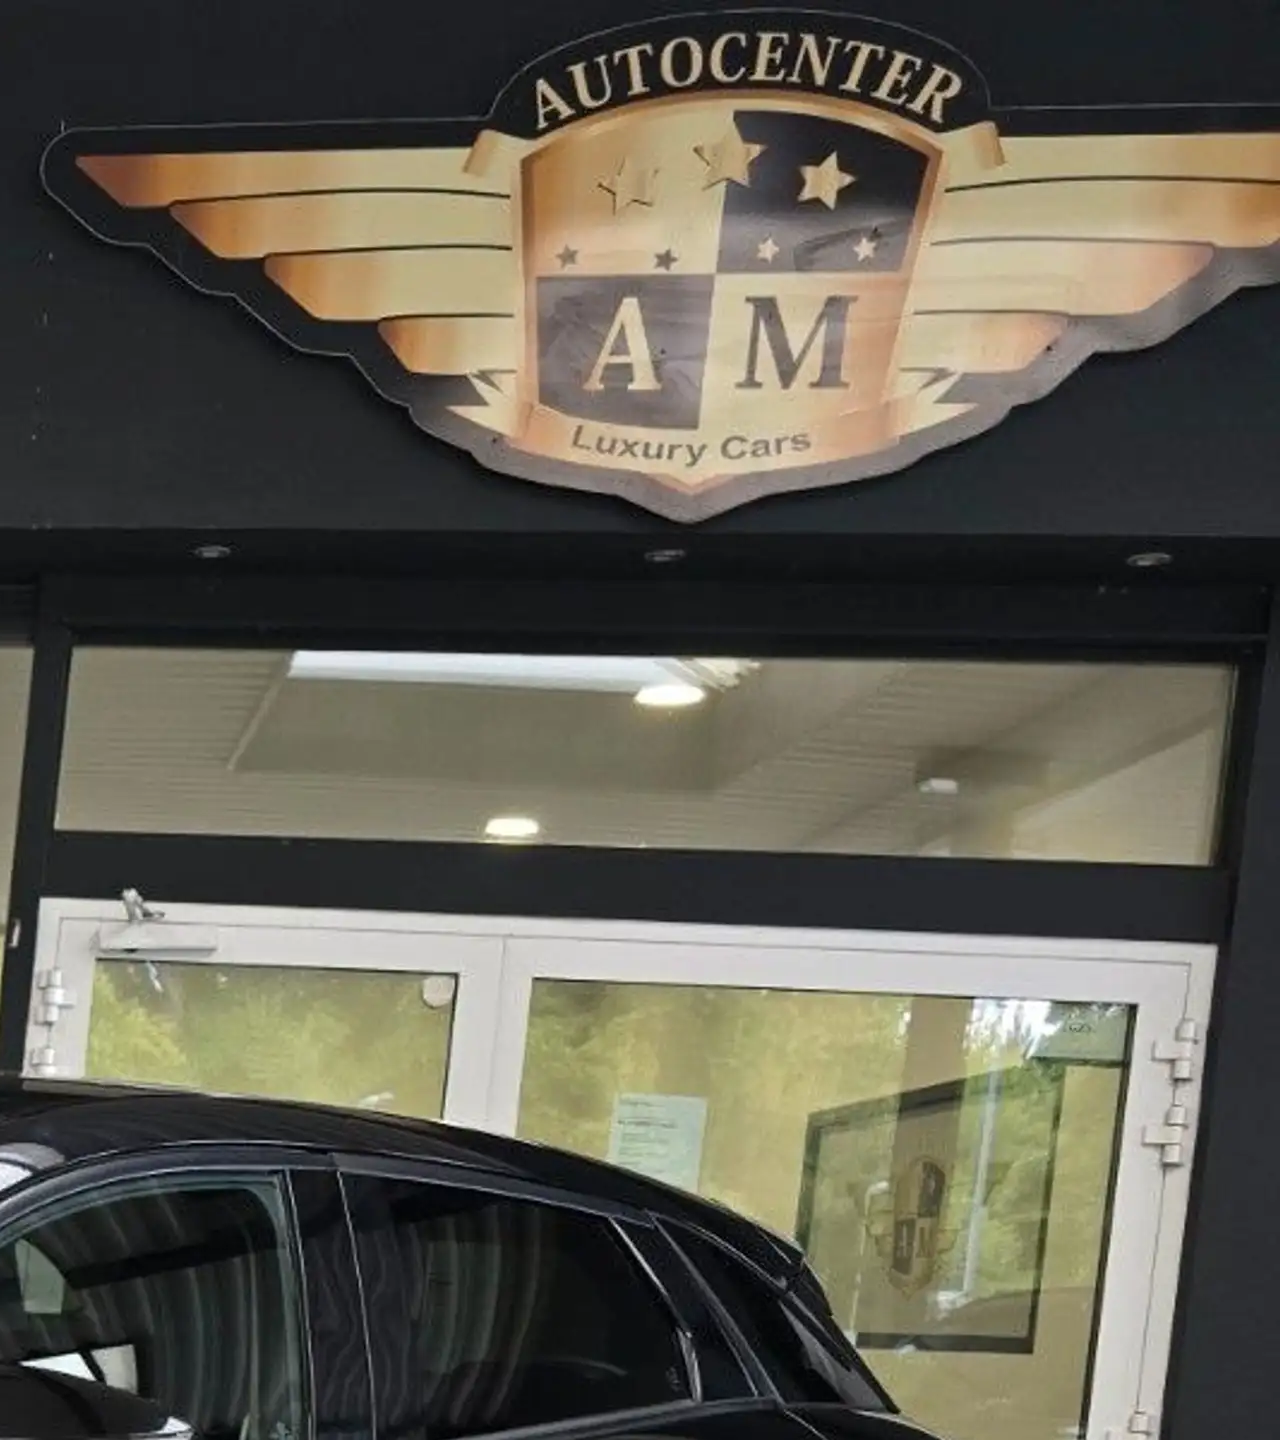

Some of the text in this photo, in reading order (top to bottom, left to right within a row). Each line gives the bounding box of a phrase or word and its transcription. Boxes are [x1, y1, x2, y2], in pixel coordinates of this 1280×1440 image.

[531, 32, 963, 129] AUTOCENTER
[583, 294, 858, 391] A M
[571, 424, 812, 468] Luxury Cars
